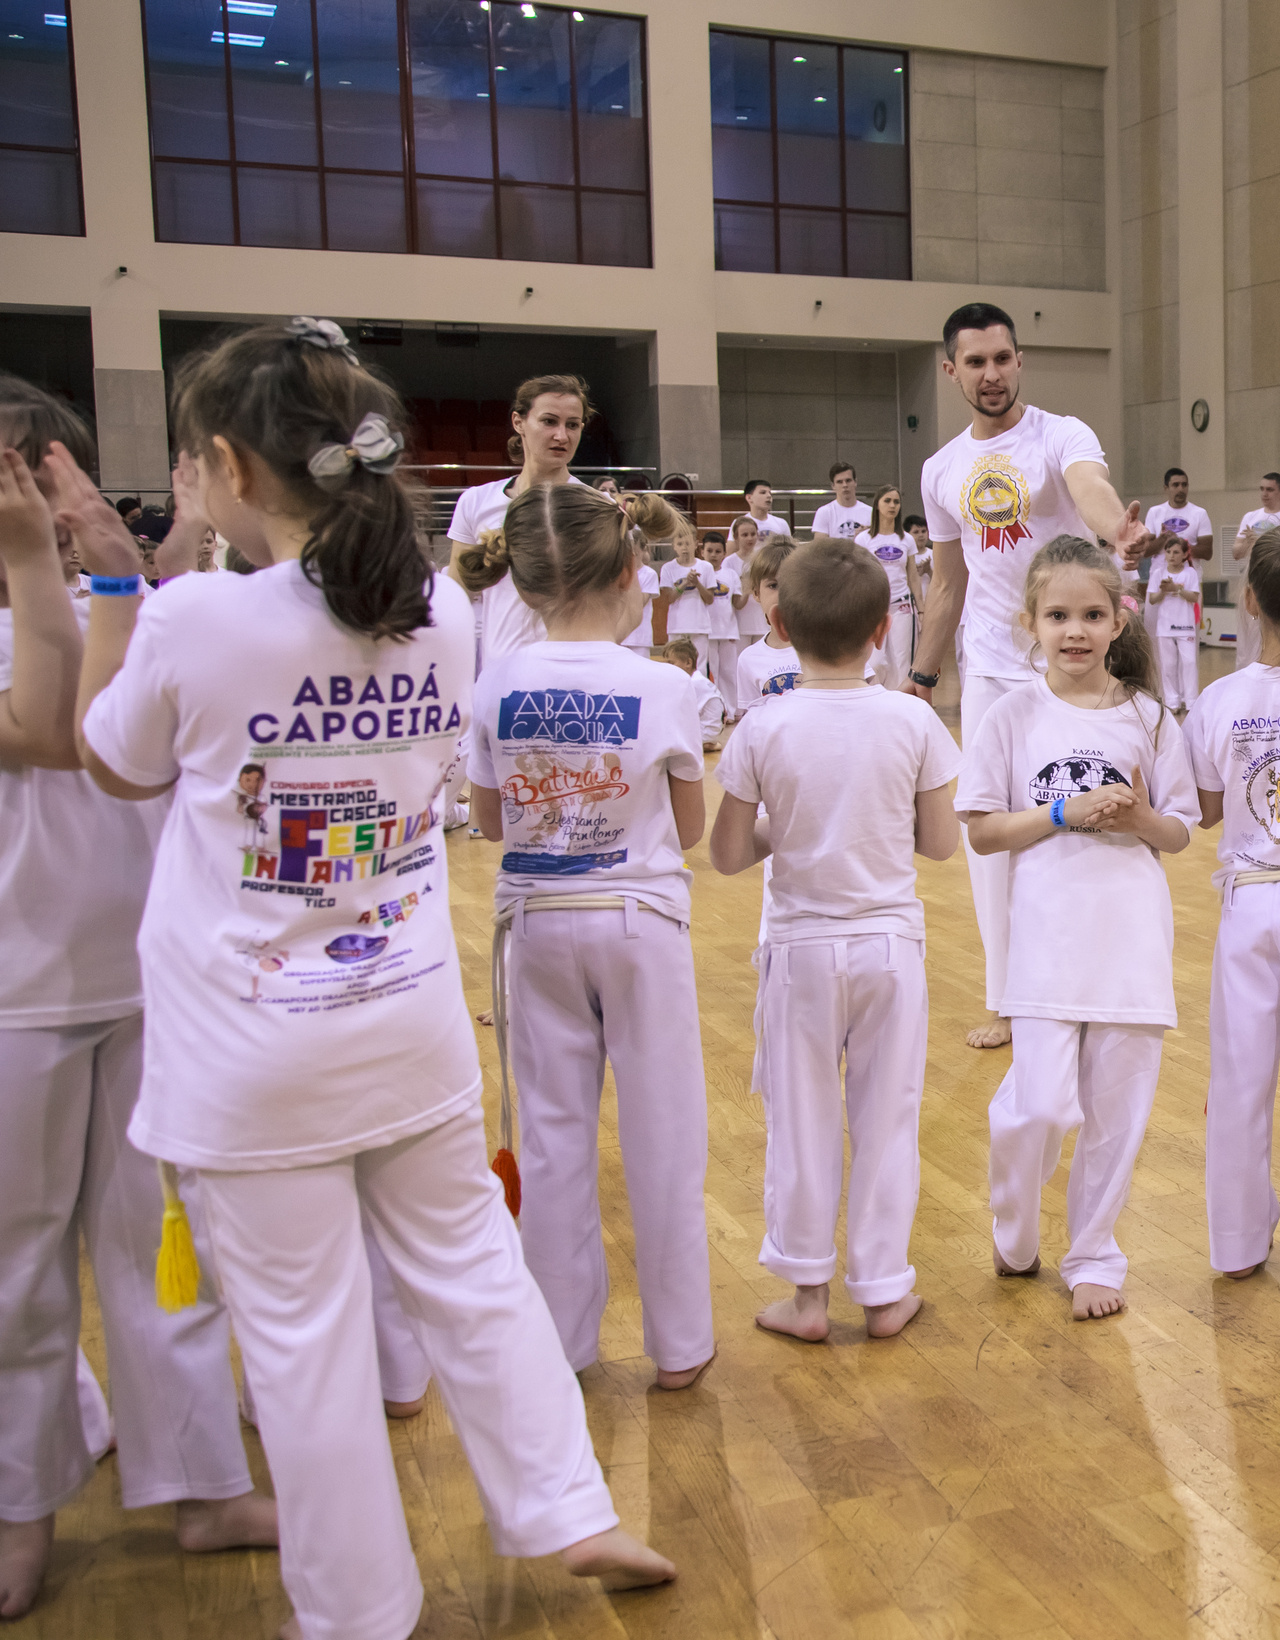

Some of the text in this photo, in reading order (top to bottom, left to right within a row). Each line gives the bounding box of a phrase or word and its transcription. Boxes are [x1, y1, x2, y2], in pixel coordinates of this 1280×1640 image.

[965, 461, 1020, 484] FRANCESES
[971, 453, 1013, 470] JOGOS
[292, 662, 440, 707] ABADÁ
[513, 689, 625, 722] ABADÁ
[247, 702, 462, 744] CAPOEIRA
[510, 720, 626, 742] CAPOEIRA
[1072, 748, 1104, 758] KAZAN
[270, 789, 377, 807] MESTRANDO
[329, 799, 397, 824] CASCÃO
[240, 880, 324, 897] PROFESSOR
[304, 897, 337, 909] TICO
